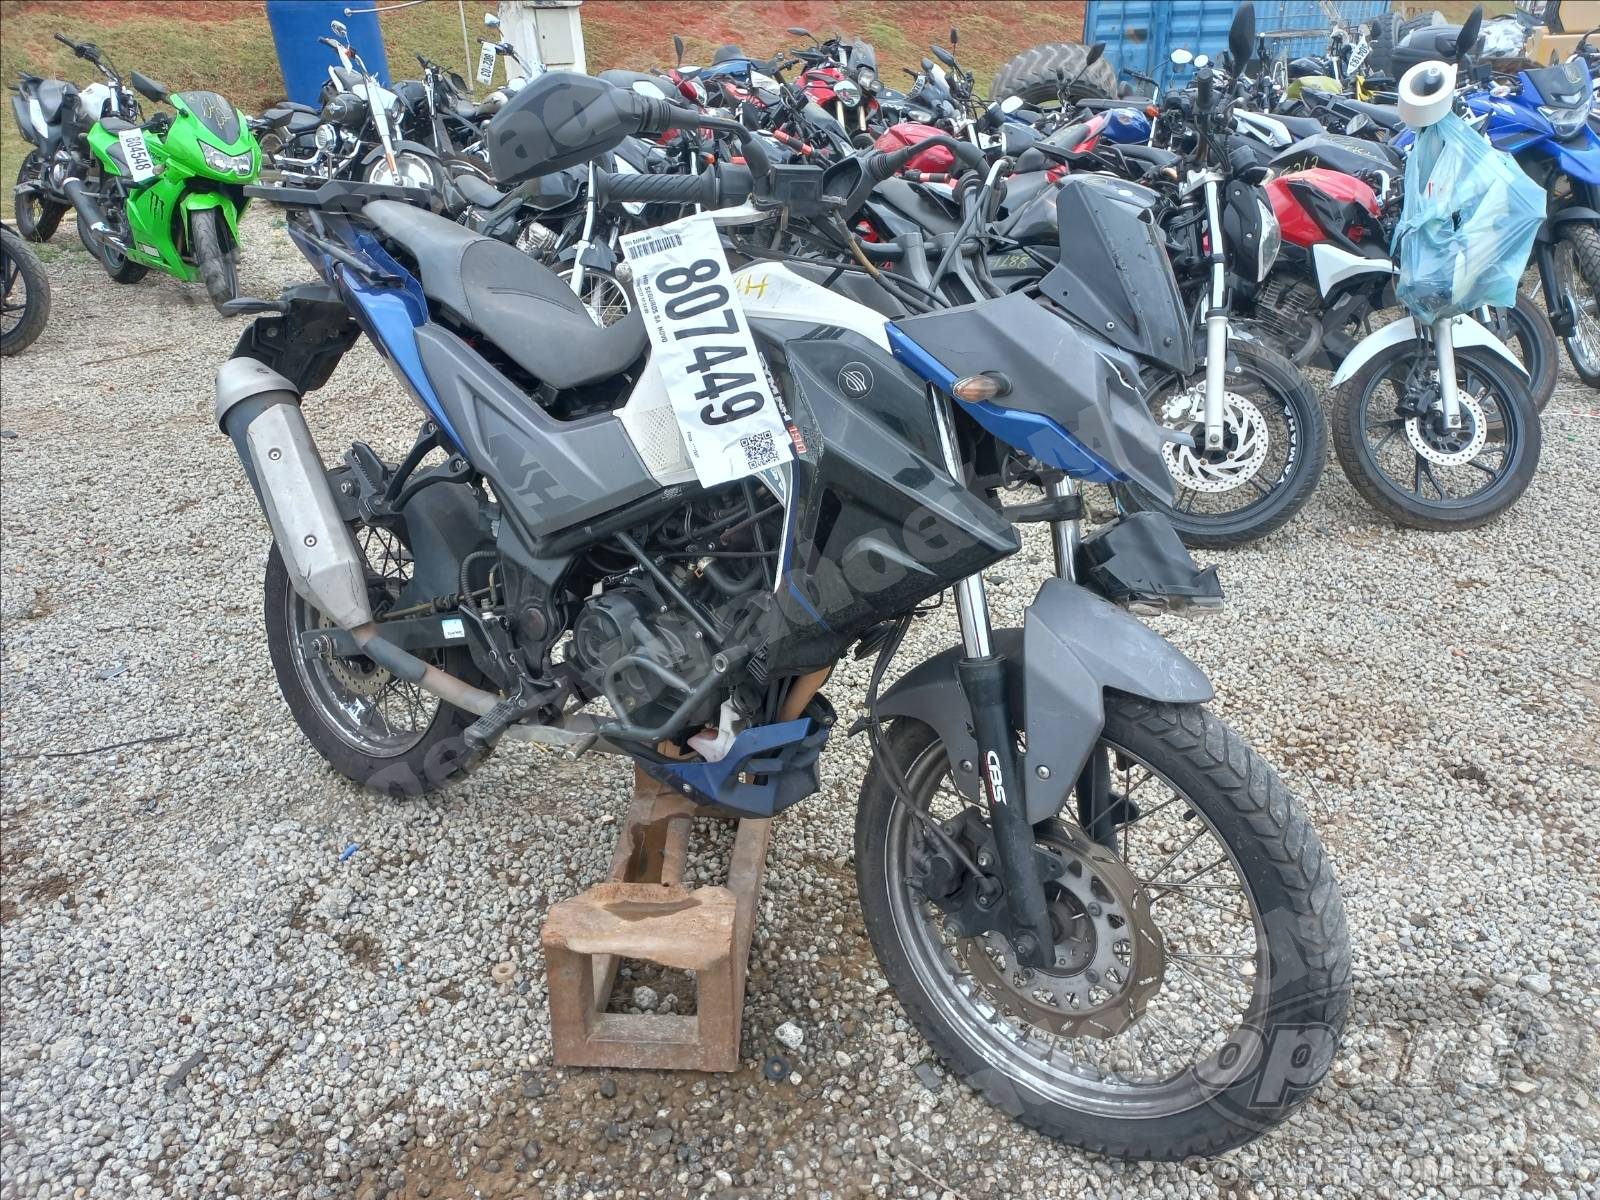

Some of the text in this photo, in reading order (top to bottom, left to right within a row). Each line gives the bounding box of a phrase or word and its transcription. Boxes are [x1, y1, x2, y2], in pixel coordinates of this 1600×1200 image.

[655, 258, 765, 426] 807449
[787, 424, 807, 454] 190
[1276, 405, 1296, 485] YAMAHA
[985, 749, 1006, 807] CBS
